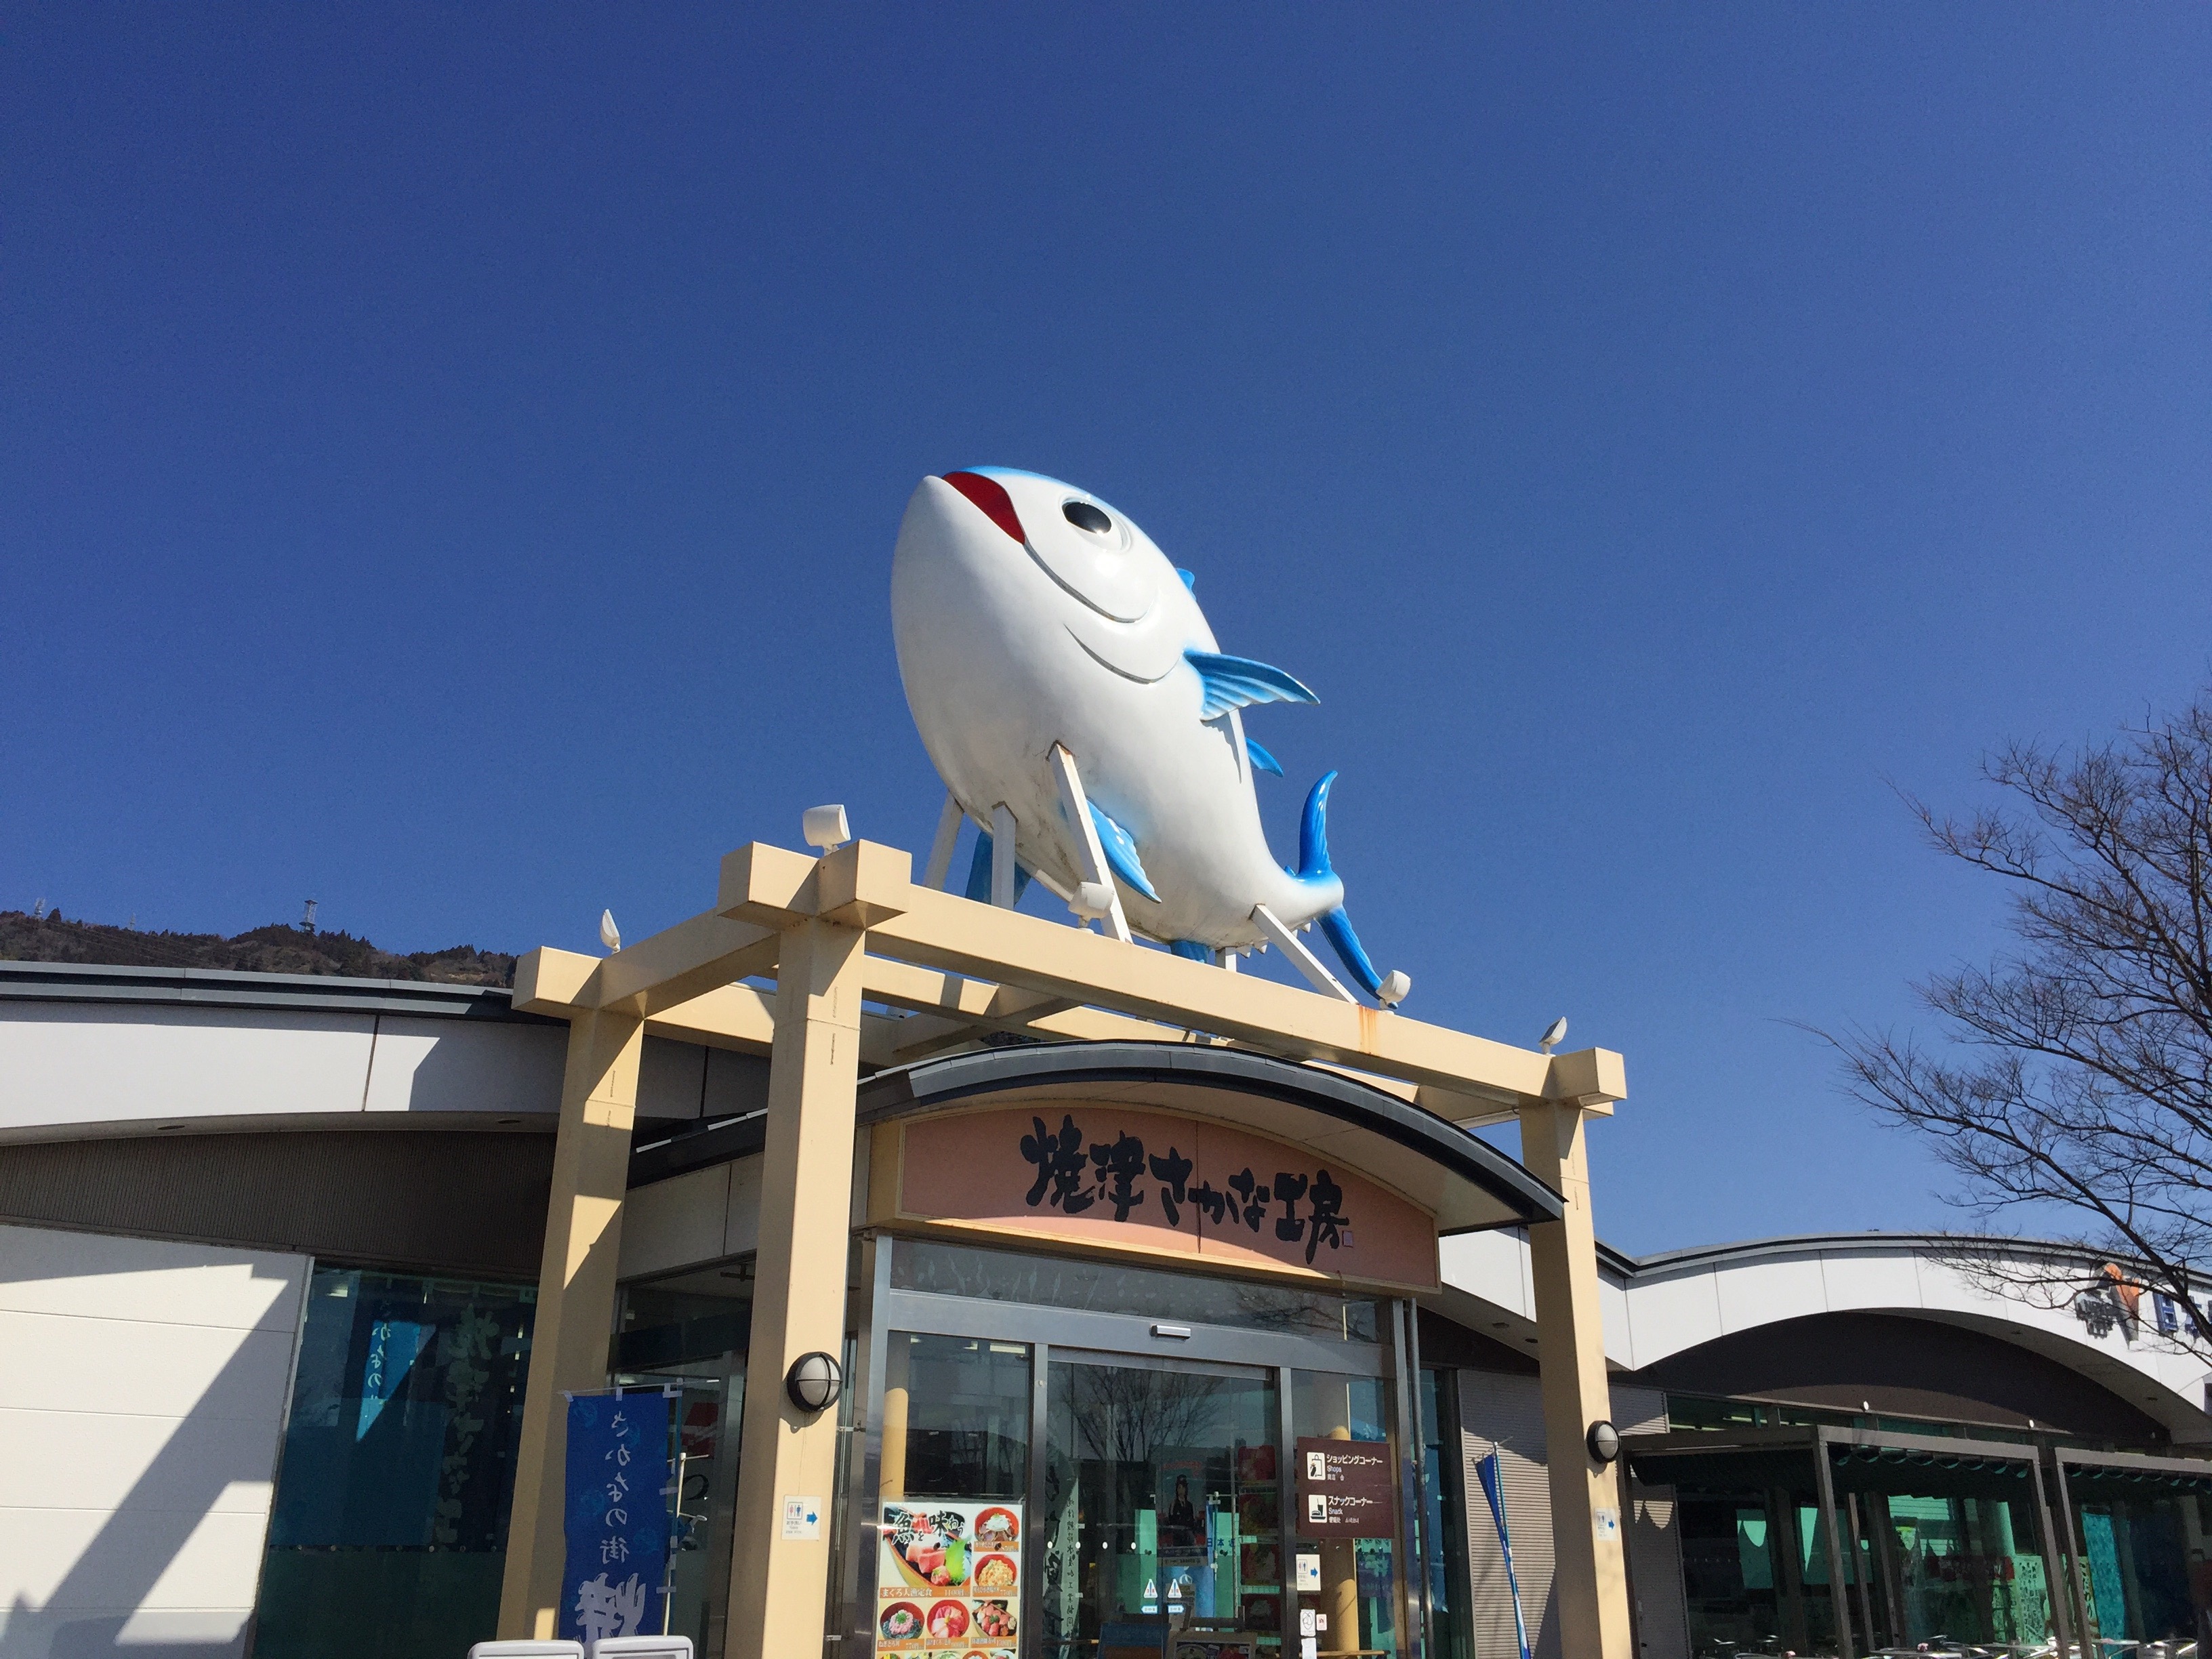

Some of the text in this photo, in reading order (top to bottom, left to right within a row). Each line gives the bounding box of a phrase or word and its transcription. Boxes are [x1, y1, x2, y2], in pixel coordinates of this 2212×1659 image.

[1019, 1114, 1349, 1263] 焼津さかな工房
[1326, 1454, 1383, 1465] ショッピングコーナー
[1328, 1496, 1373, 1507] スナックコーナー
